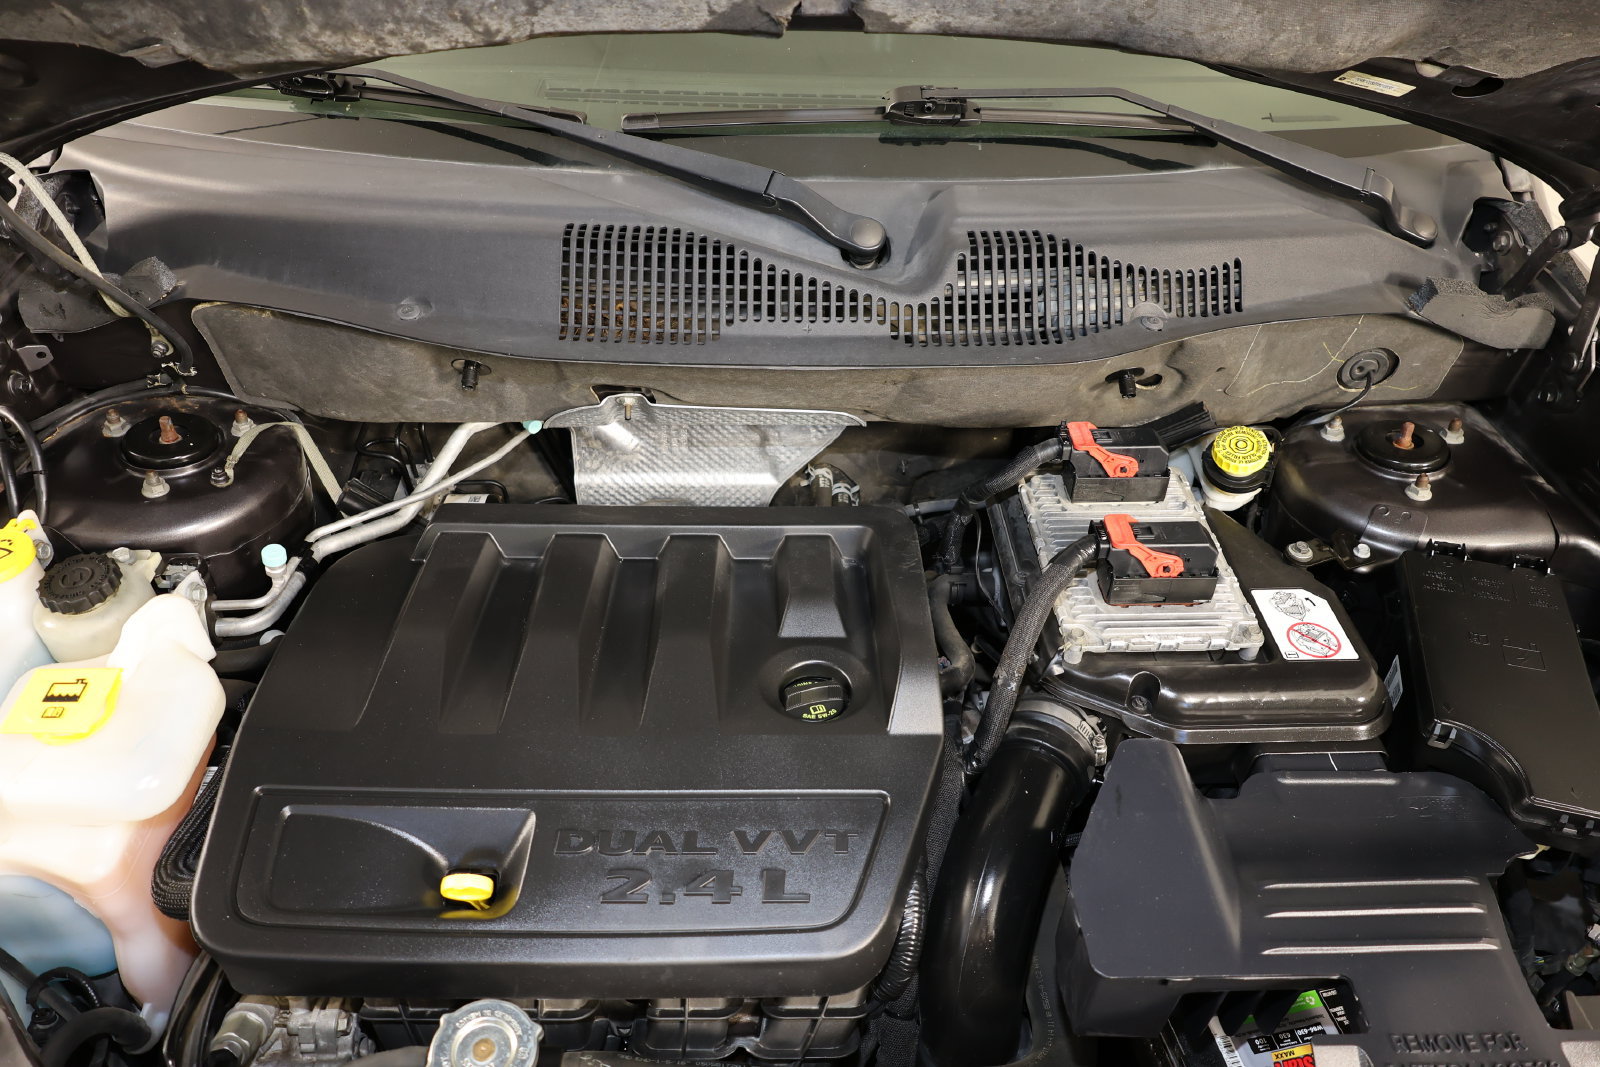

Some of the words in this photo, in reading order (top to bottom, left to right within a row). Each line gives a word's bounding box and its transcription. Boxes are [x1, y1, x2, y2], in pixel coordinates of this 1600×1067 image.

[553, 829, 719, 855] DUAL
[731, 829, 859, 855] VVT
[1389, 1032, 1481, 1054] REMOVE
[1481, 1031, 1529, 1053] FOR
[1273, 1049, 1296, 1060] MAXX
